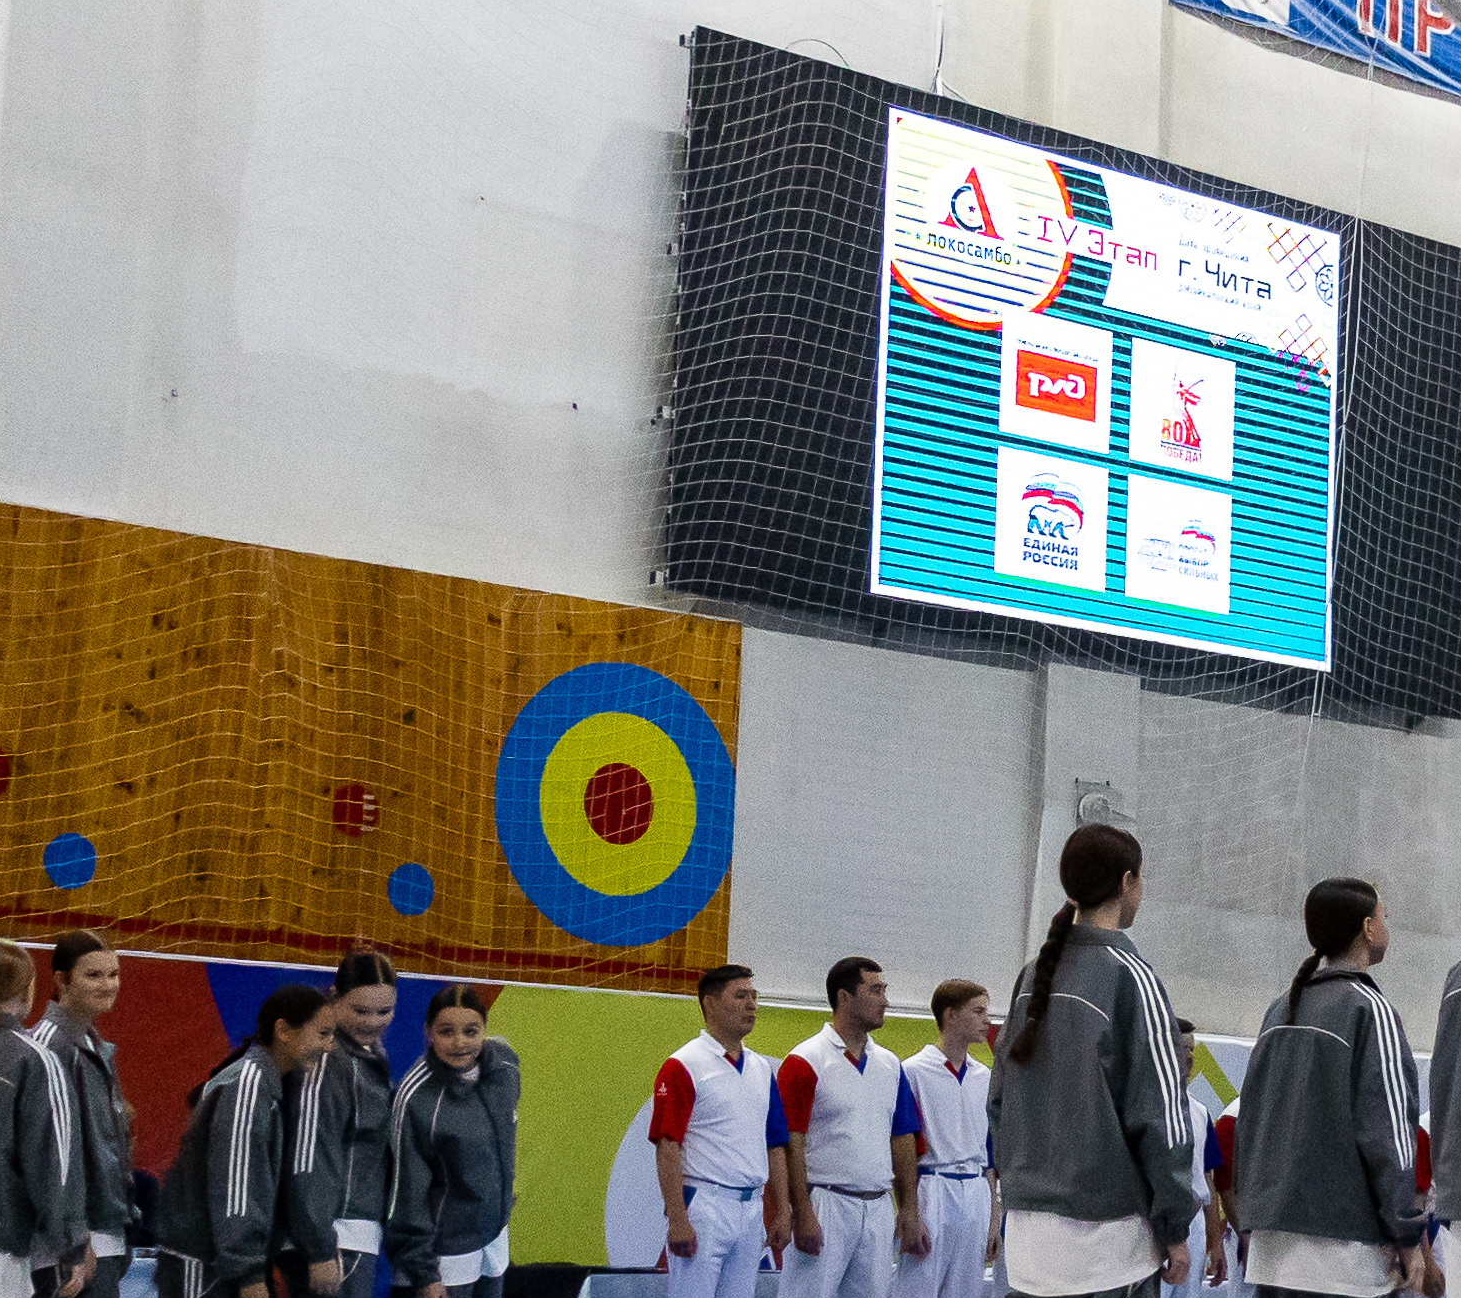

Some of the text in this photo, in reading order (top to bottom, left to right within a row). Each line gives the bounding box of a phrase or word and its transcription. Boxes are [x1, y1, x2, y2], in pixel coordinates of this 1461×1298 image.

[926, 232, 1012, 265] локосамбо
[1037, 215, 1157, 271] IV Этап
[1205, 259, 1271, 300] Чита
[1160, 418, 1184, 443] 80
[1160, 443, 1202, 464] ПОБЕДА!
[1023, 537, 1078, 557] ЕДИНАЯ
[1023, 550, 1078, 571] РОССИЯ
